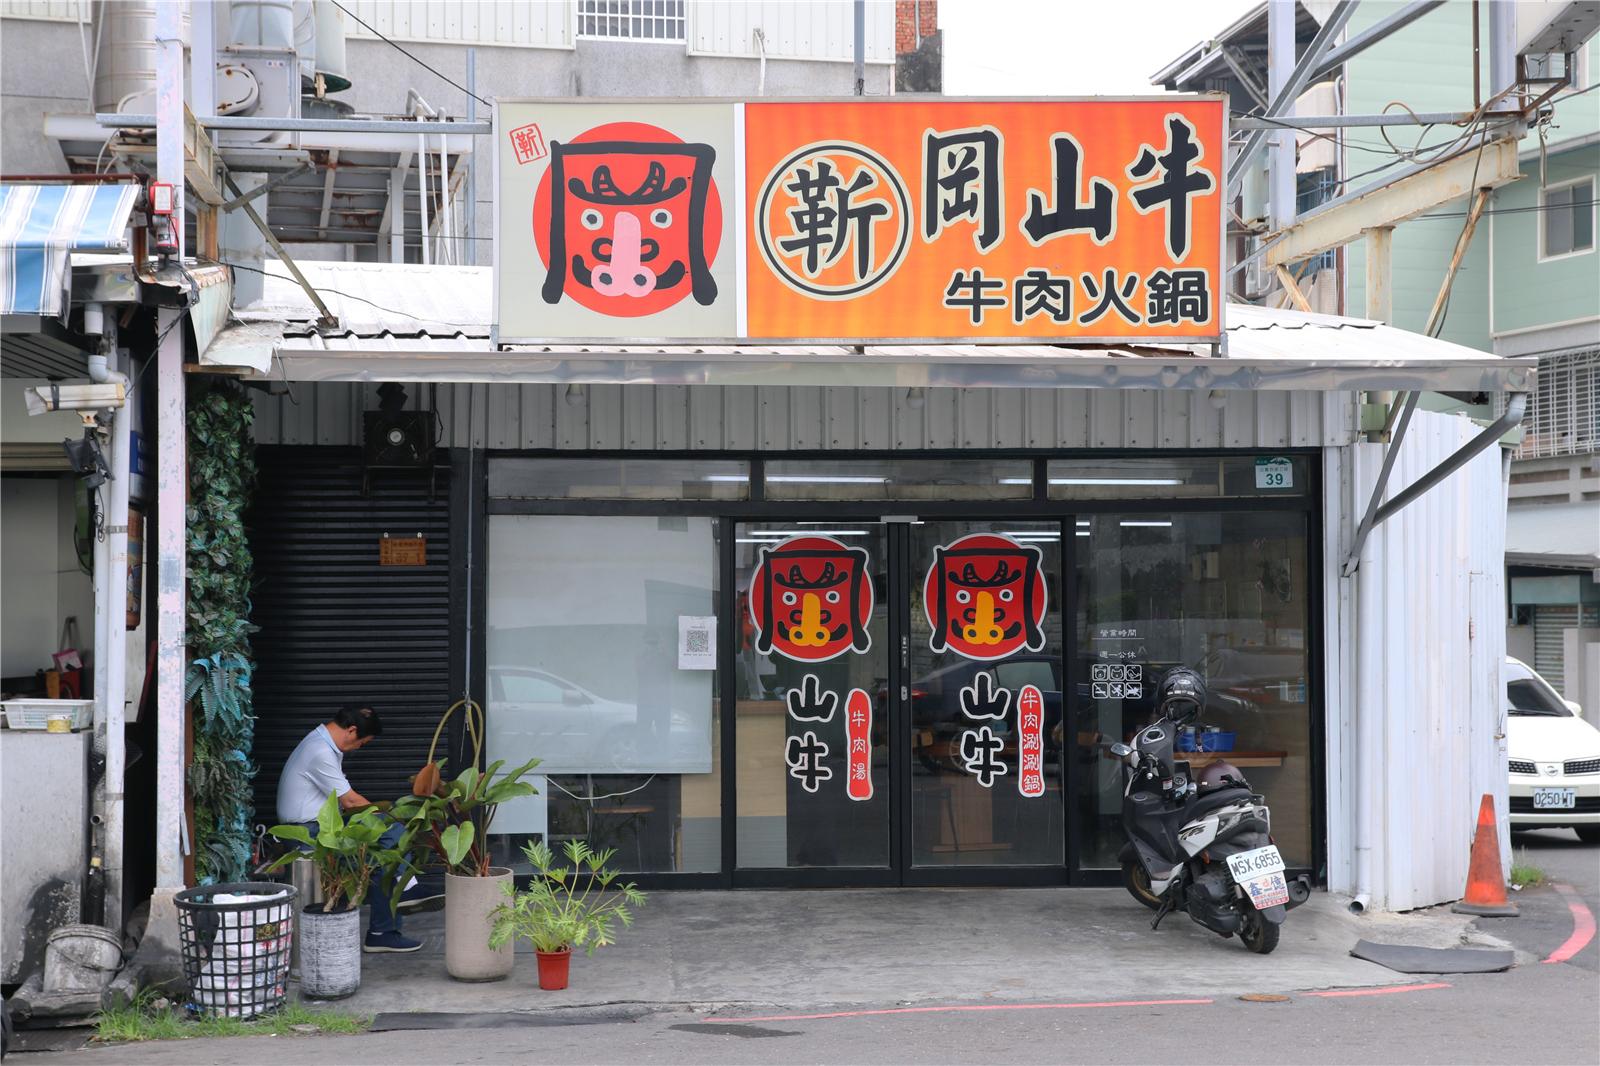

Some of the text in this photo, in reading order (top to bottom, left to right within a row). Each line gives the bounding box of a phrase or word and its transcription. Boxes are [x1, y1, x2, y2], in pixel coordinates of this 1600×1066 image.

[780, 114, 1214, 280] 靳 岡山牛
[944, 269, 1211, 324] 牛肉火鍋
[1266, 473, 1284, 485] 39
[1100, 629, 1137, 637] 營業時間
[785, 674, 838, 793] 山牛
[852, 710, 866, 780] 牛肉湯
[960, 671, 1011, 787] 山牛
[1023, 691, 1040, 792] 牛肉涮涮鍋
[1534, 792, 1575, 806] 0250-WT
[1231, 852, 1281, 876] MSX-6855
